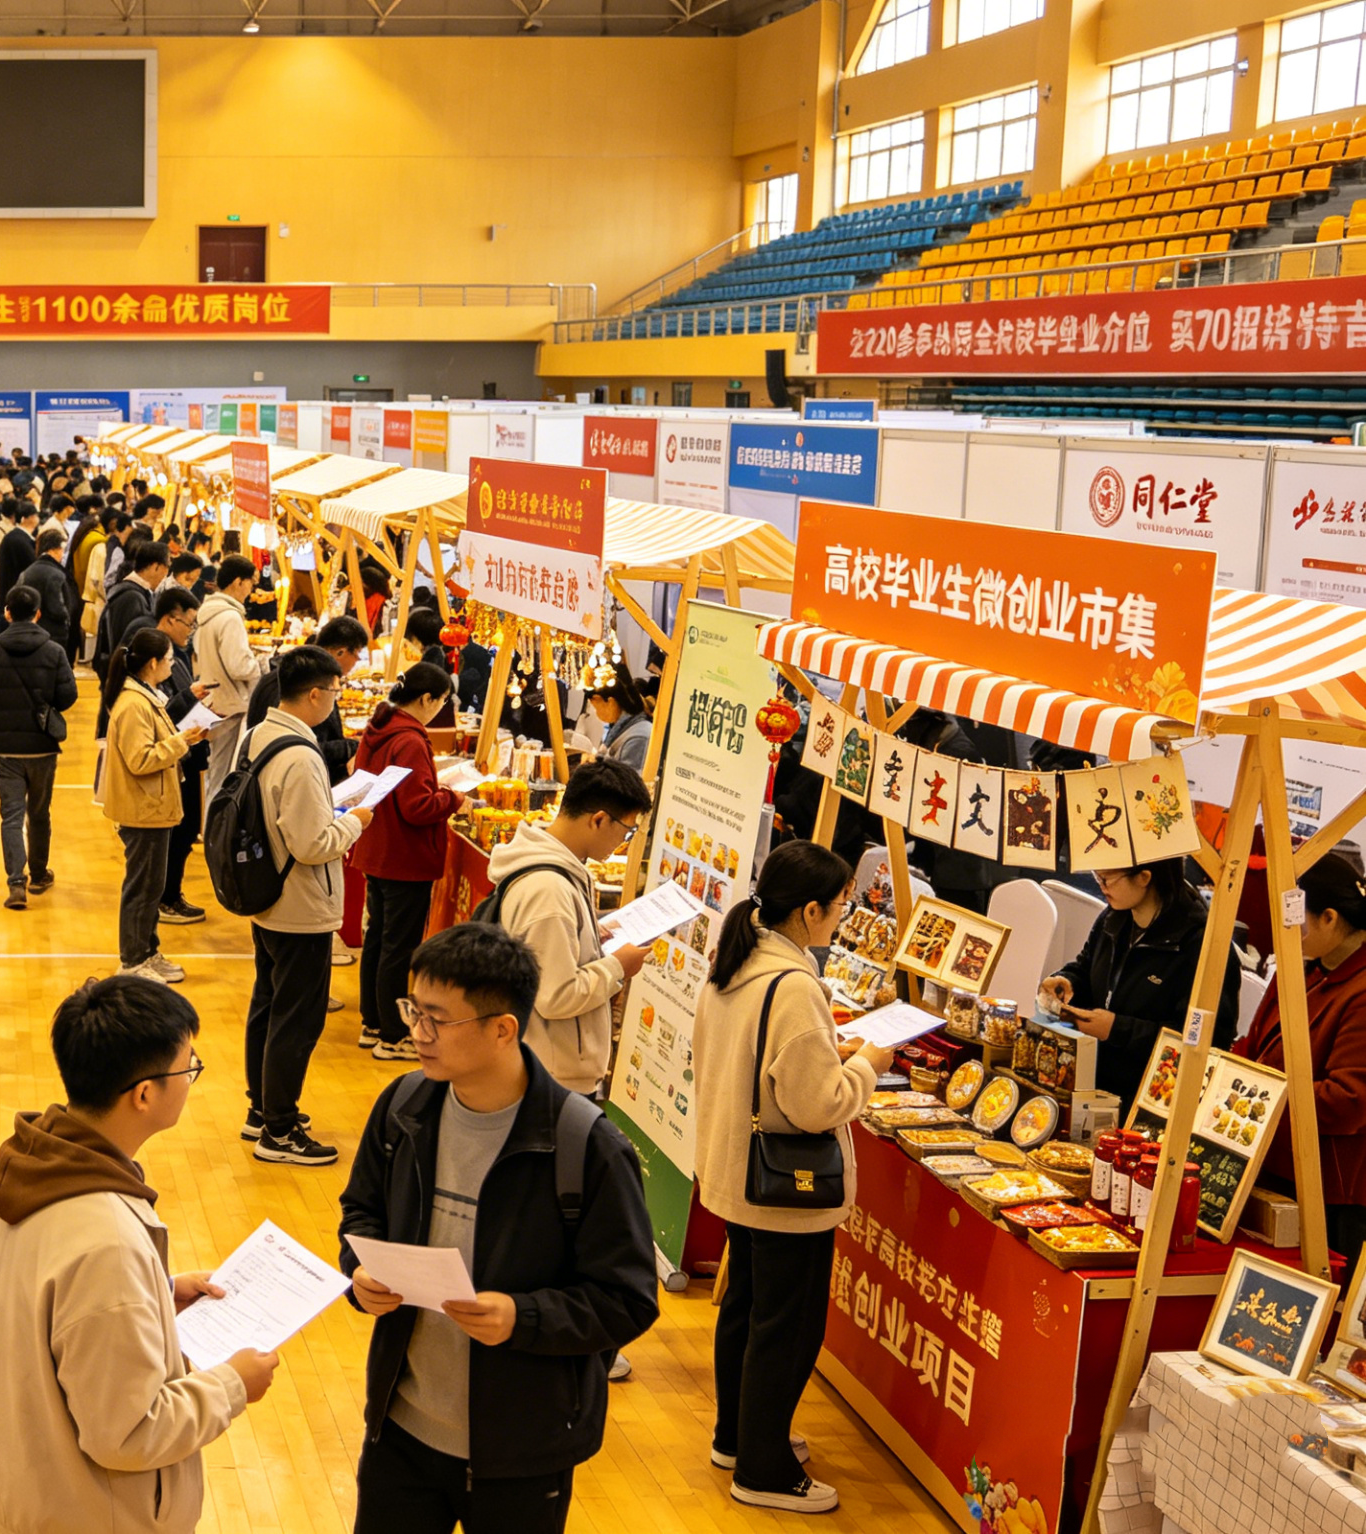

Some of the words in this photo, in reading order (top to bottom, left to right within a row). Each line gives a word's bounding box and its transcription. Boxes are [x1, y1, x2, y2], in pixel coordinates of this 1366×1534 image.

[1132, 474, 1219, 523] 同仁堂
[825, 543, 1157, 660] 高校毕业生微创业市集
